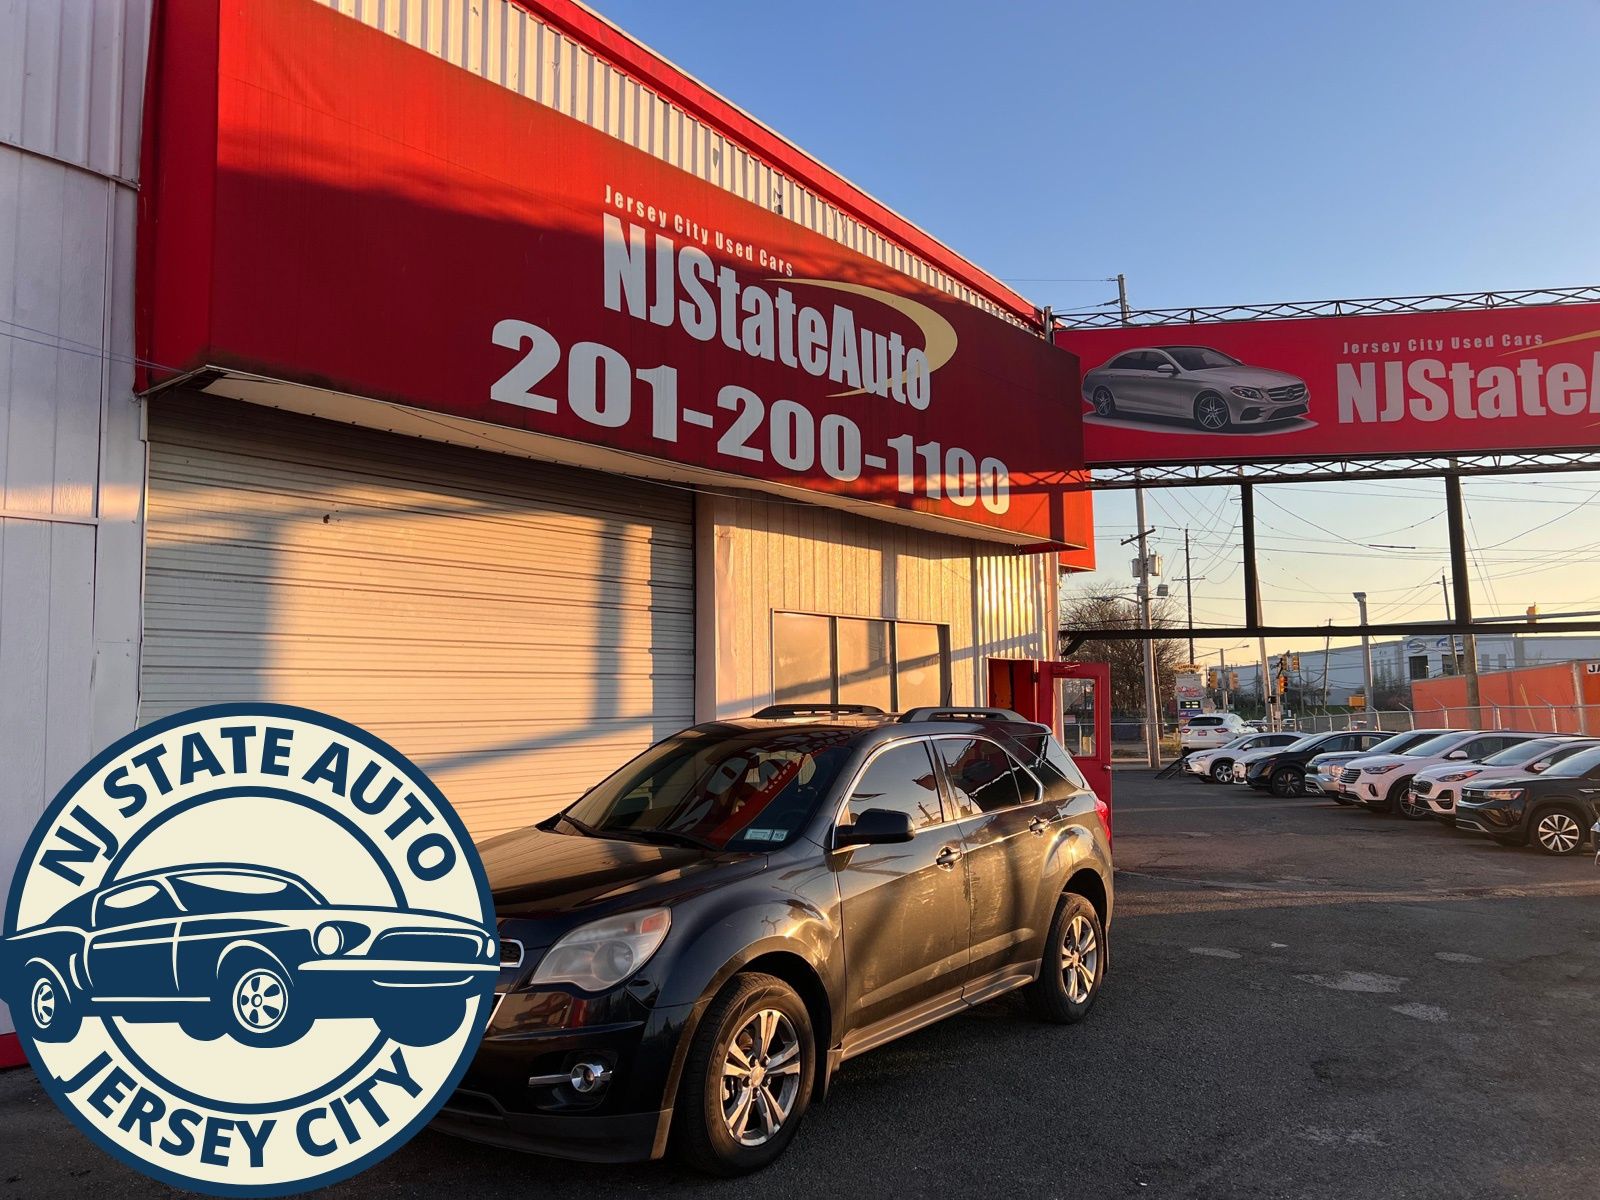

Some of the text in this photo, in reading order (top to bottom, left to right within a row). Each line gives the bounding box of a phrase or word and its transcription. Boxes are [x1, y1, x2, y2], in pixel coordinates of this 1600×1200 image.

[605, 184, 793, 277] Jersey City Used Cars
[603, 212, 930, 411] NJStateAuto
[1343, 333, 1543, 354] Jersey City Used Cars
[490, 318, 1010, 515] 201-200-1100
